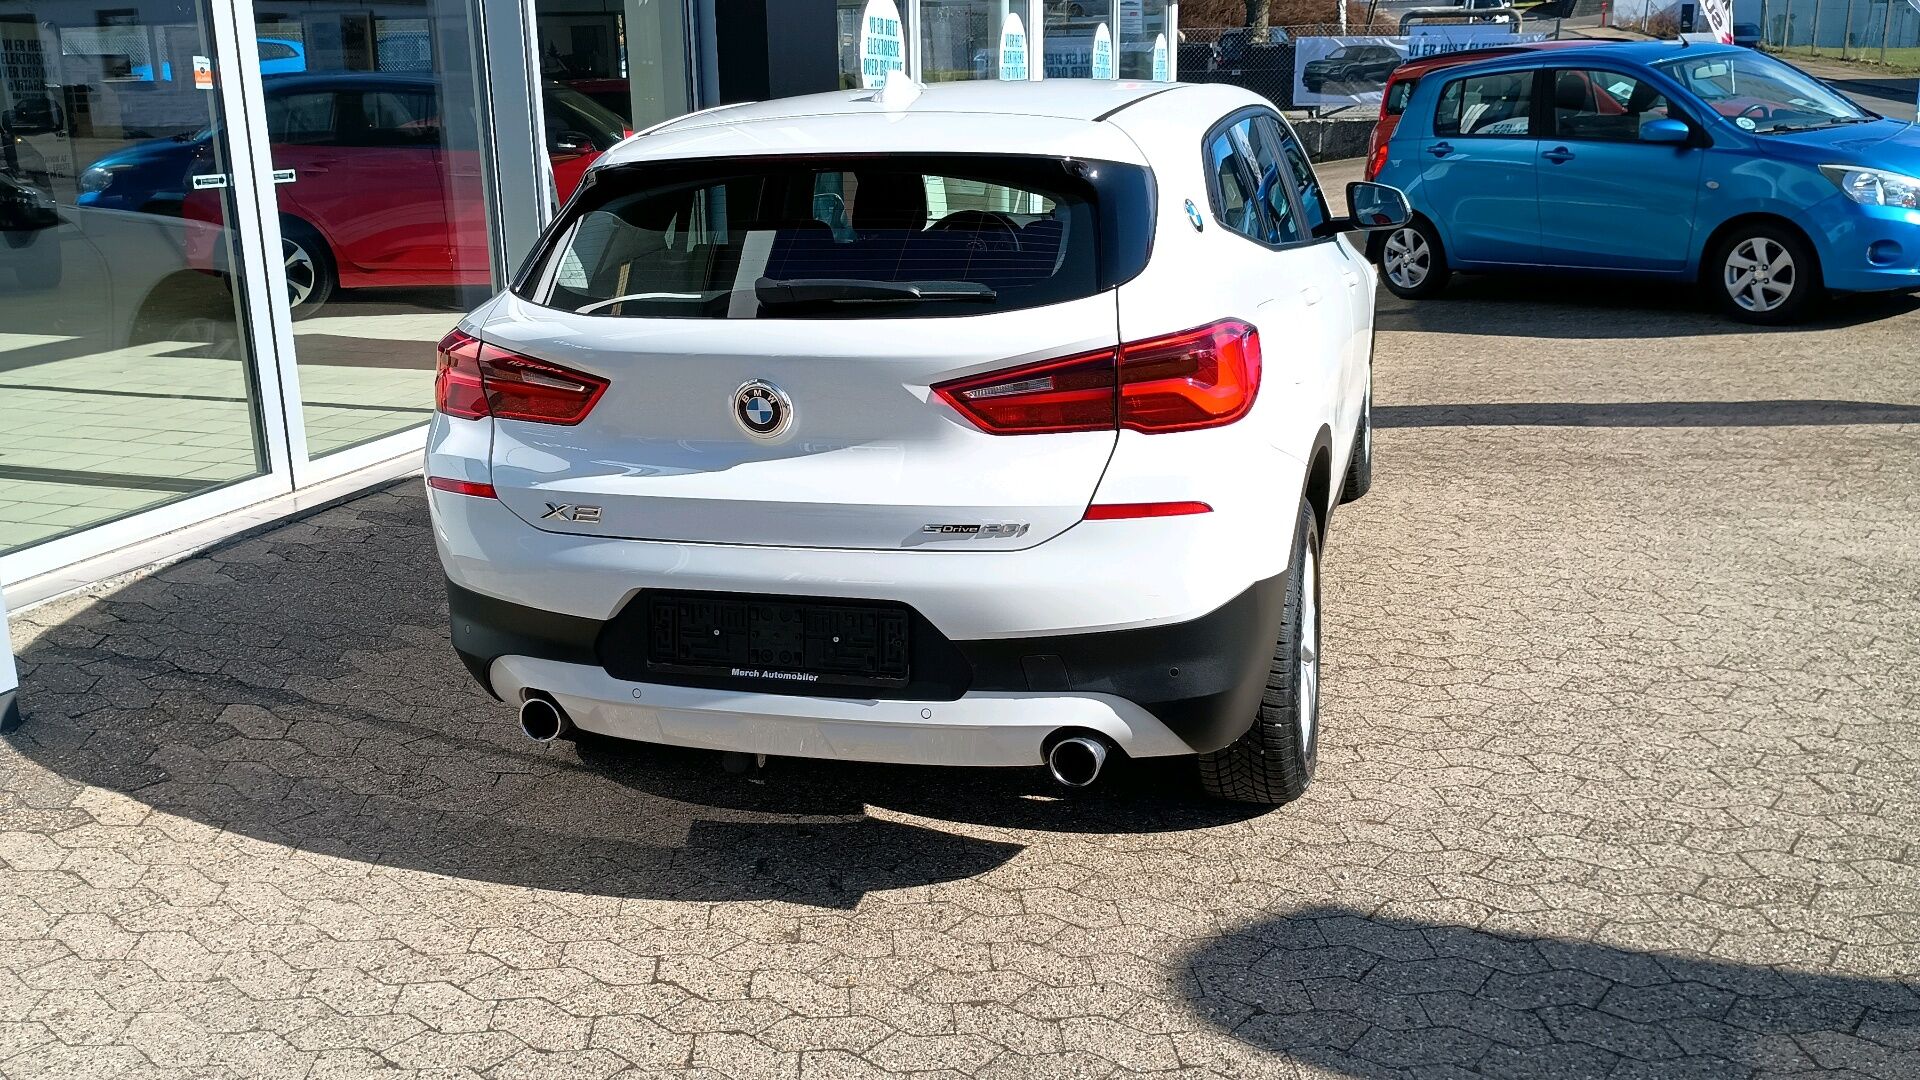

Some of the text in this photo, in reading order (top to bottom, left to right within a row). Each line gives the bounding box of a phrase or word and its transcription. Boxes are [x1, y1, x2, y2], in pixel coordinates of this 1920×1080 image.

[869, 16, 898, 37] VI ER HELT
[2, 39, 12, 51] VI
[15, 39, 26, 51] ER
[867, 37, 900, 57] ELEKTRISKE
[1408, 44, 1420, 57] VI
[1423, 43, 1437, 56] ER
[863, 58, 879, 75] OVER
[741, 389, 777, 404] BMW
[540, 501, 603, 523] X2
[762, 670, 819, 682] Automobiler
